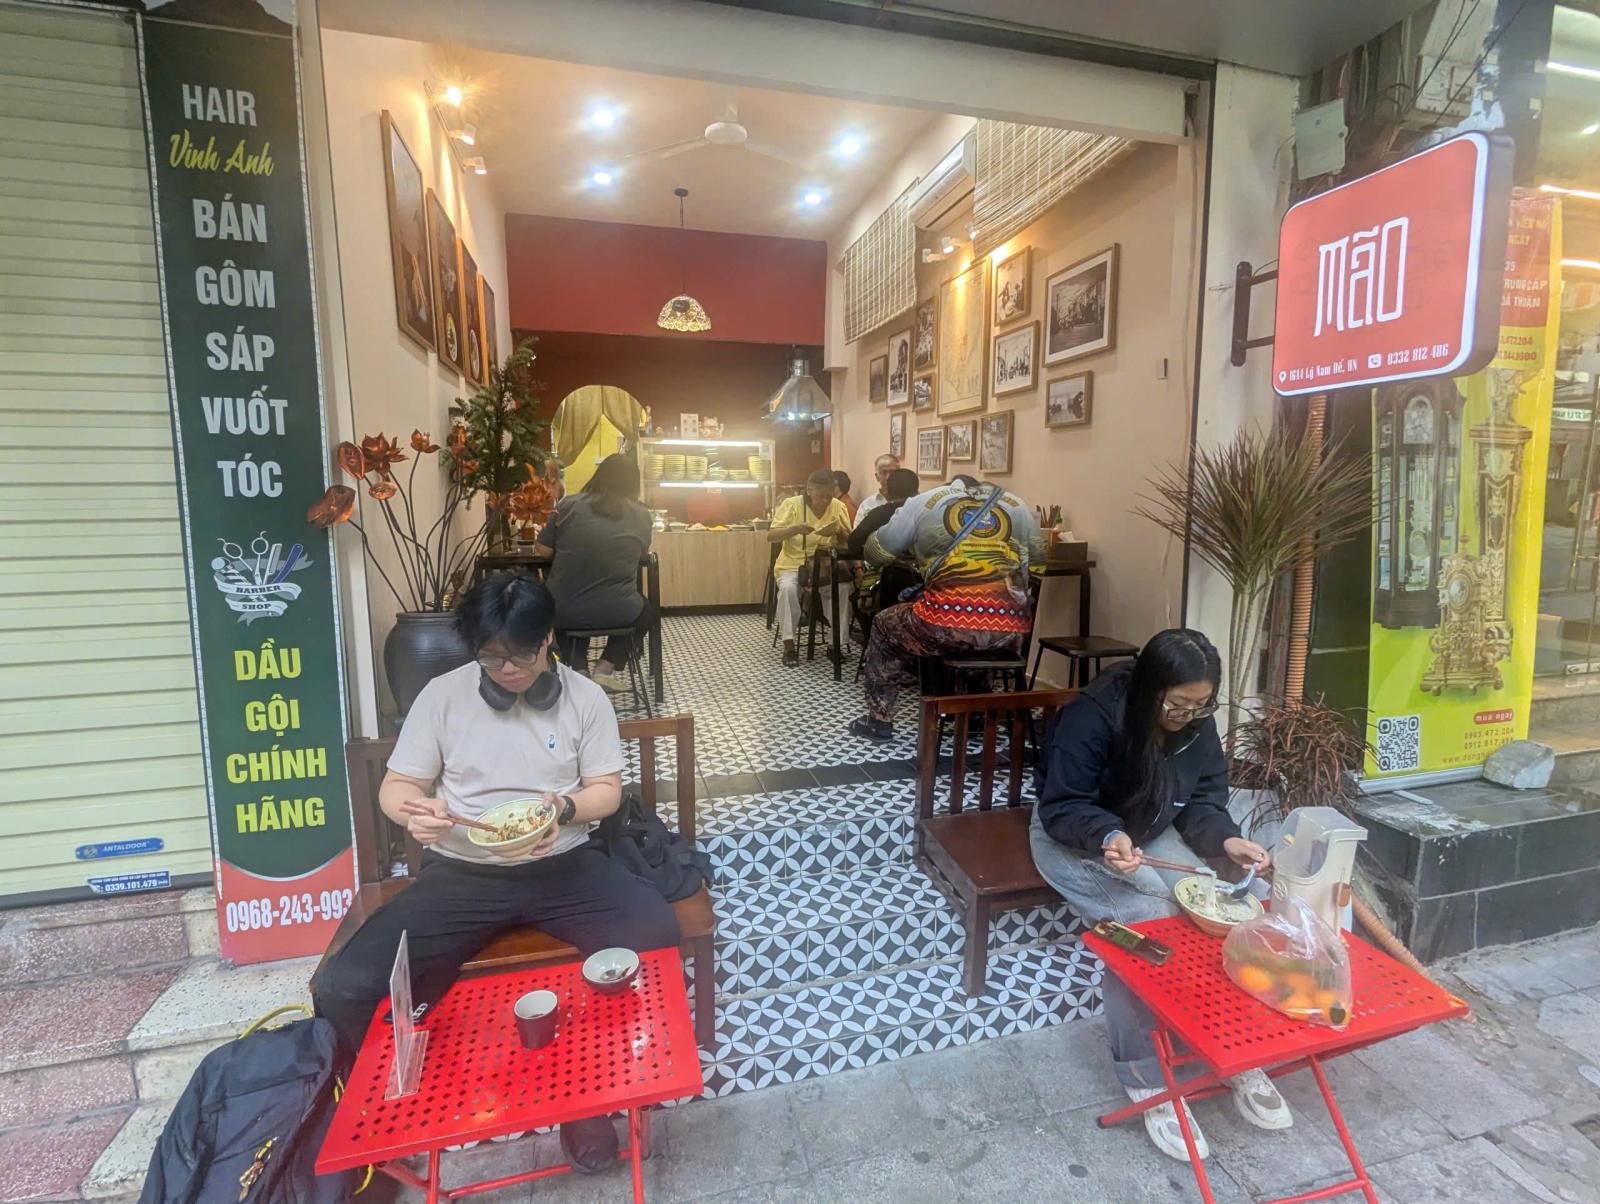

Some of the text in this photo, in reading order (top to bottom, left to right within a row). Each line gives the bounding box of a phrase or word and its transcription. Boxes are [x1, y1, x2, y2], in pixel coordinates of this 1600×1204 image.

[182, 84, 257, 127] HAIR
[169, 128, 275, 176] Vinh Anh
[192, 194, 267, 243] BÁN
[195, 260, 276, 309] GÔM
[206, 327, 275, 371] SÁP
[1315, 365, 1331, 377] Nam
[1387, 343, 1449, 366] 0332 812 486
[201, 385, 288, 436] VUỐT
[217, 453, 283, 498] TÓC
[235, 585, 282, 594] BARBER
[234, 637, 302, 681] DẦU
[245, 693, 301, 737] GỘI
[226, 747, 328, 784] CHÍNH
[236, 796, 326, 833] HÃNG
[105, 880, 157, 892] 0339.101.479
[226, 888, 353, 933] 0968-243-993
